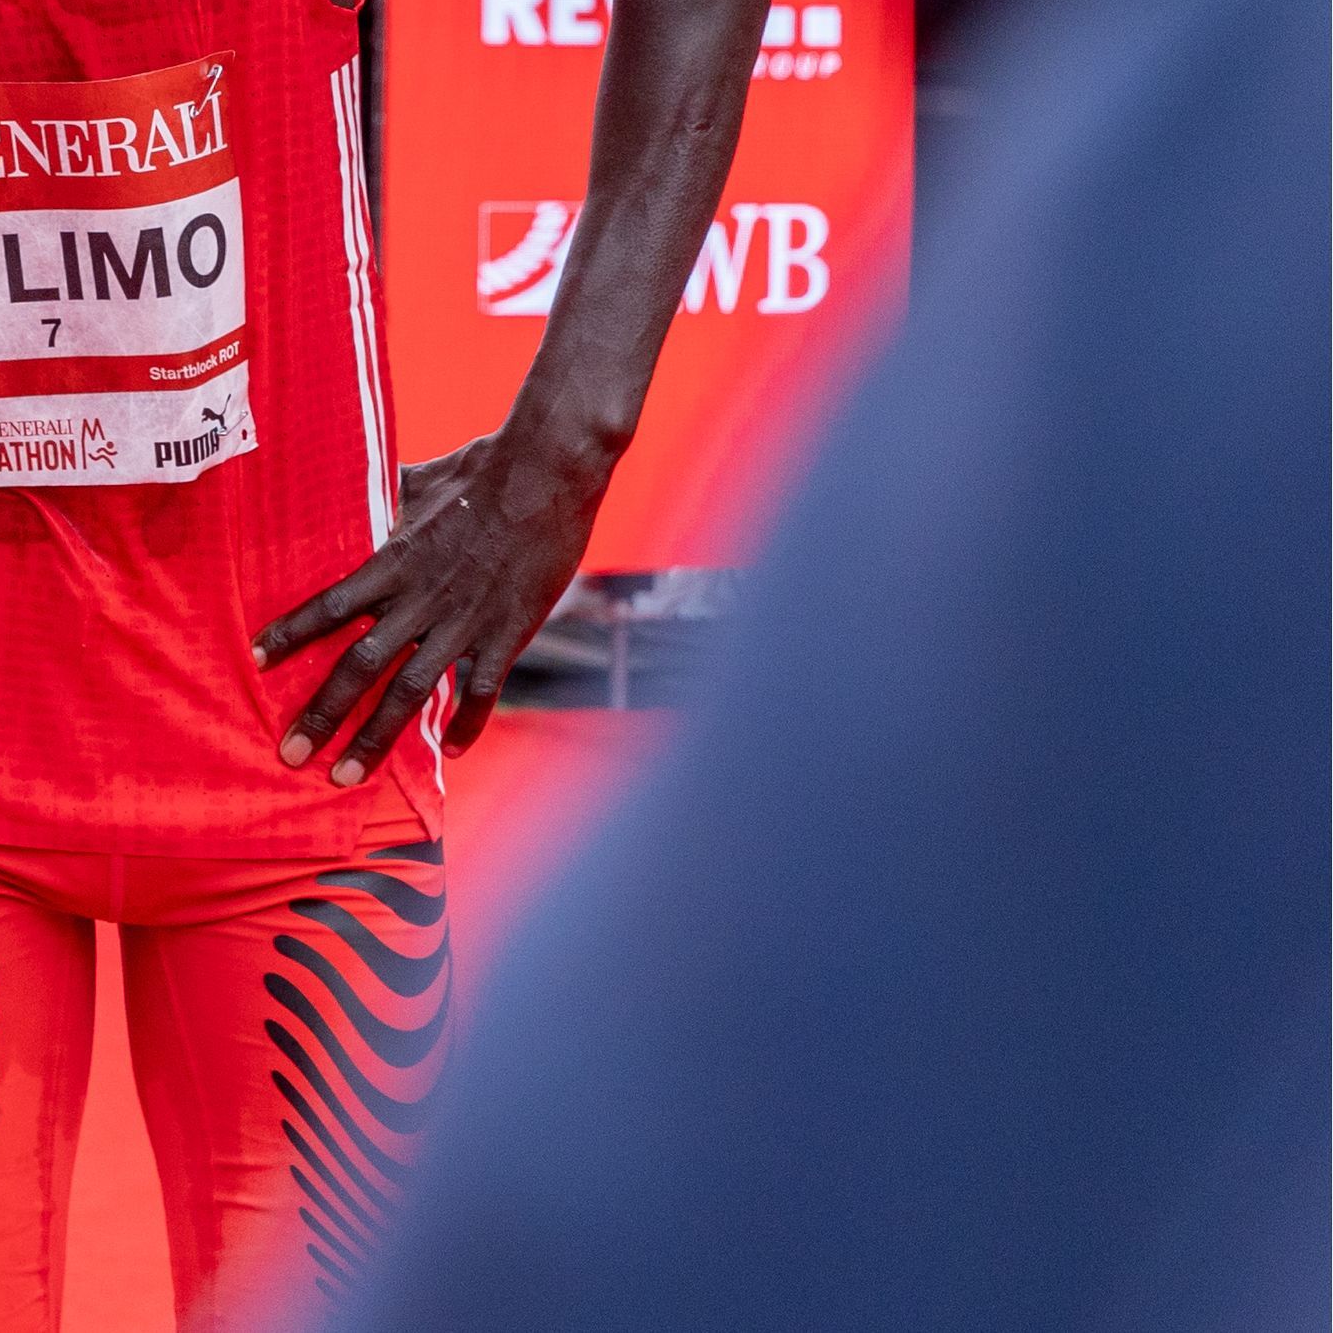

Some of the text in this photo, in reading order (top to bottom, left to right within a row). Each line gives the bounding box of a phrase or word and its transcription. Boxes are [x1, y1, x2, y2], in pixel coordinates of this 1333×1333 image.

[676, 202, 832, 315] WB
[41, 318, 62, 348] 7
[149, 340, 241, 381] Startblock ROT
[154, 426, 220, 468] PUMA
